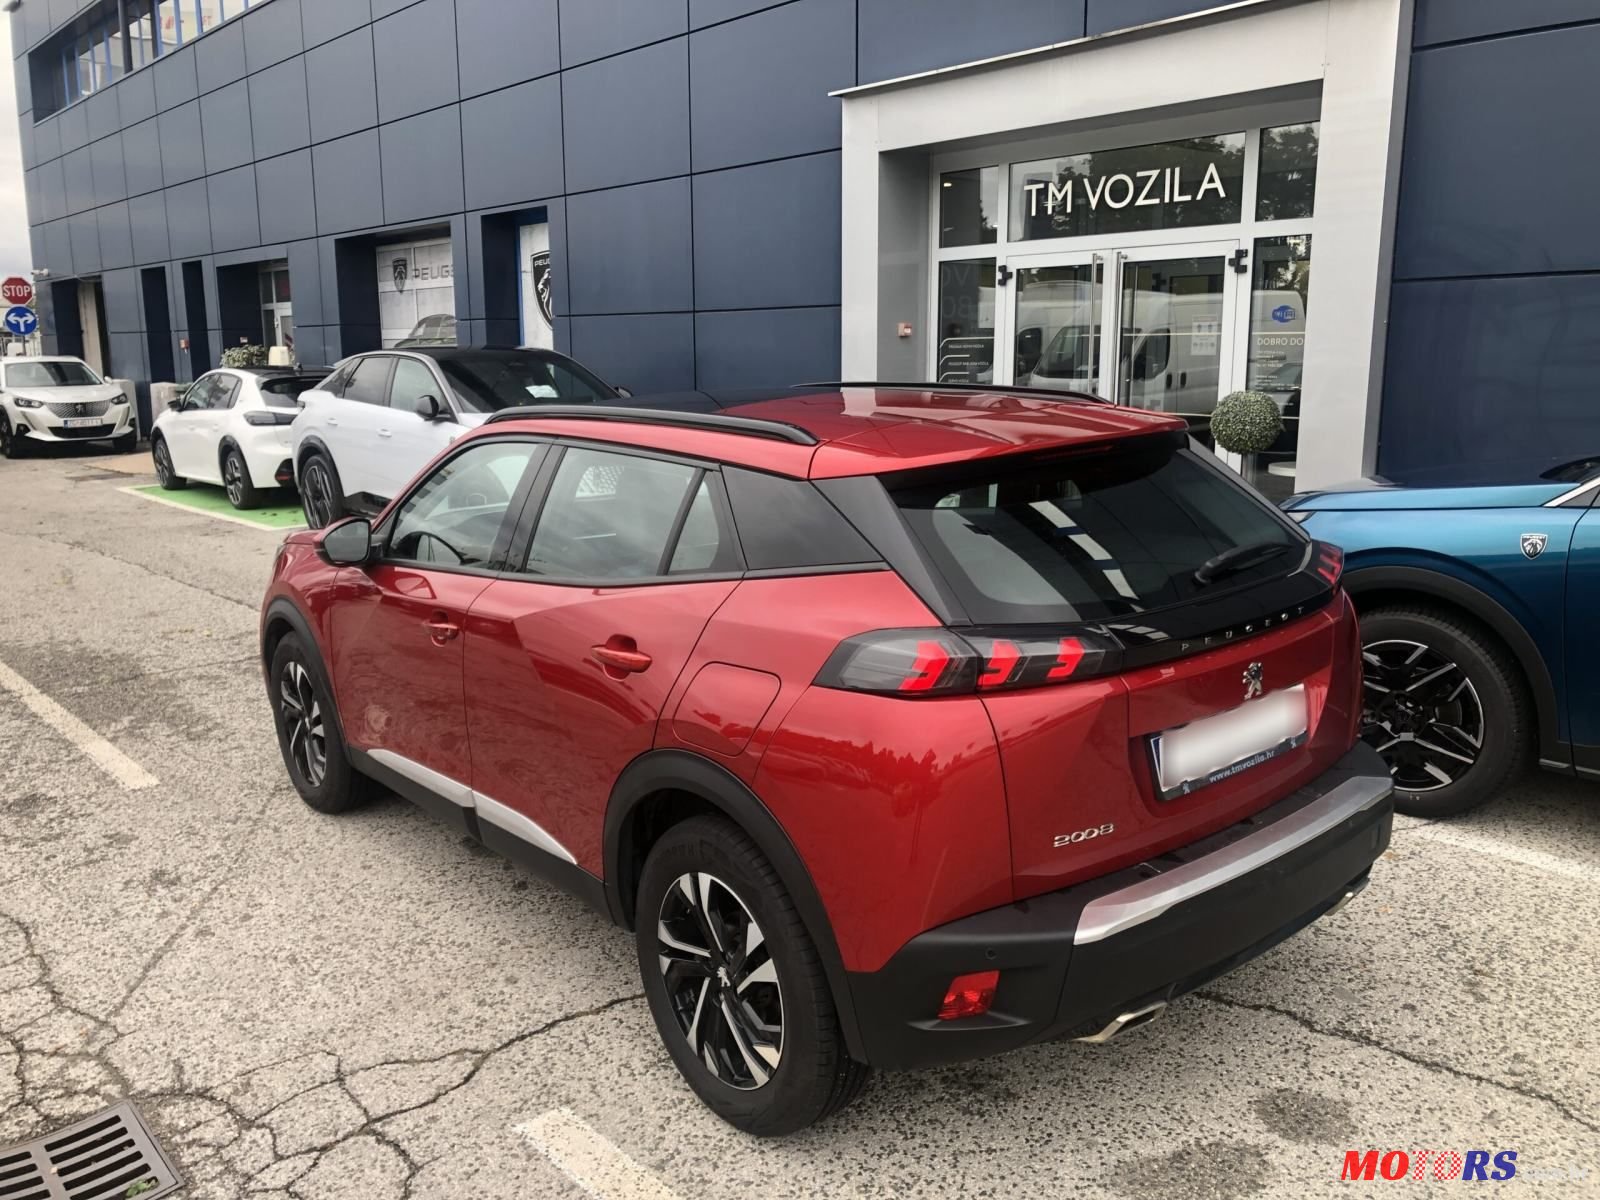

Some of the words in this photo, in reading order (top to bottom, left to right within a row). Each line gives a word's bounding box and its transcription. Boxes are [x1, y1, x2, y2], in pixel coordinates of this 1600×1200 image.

[1023, 180, 1073, 217] TM
[1083, 162, 1227, 211] VOZILA
[411, 264, 454, 281] PEUG
[3, 285, 31, 297] STOP
[1256, 337, 1288, 346] DOBRO
[1181, 606, 1304, 652] PEUGEOT
[1208, 750, 1275, 783] www.tmvozila.hr
[1053, 823, 1115, 848] 2008
